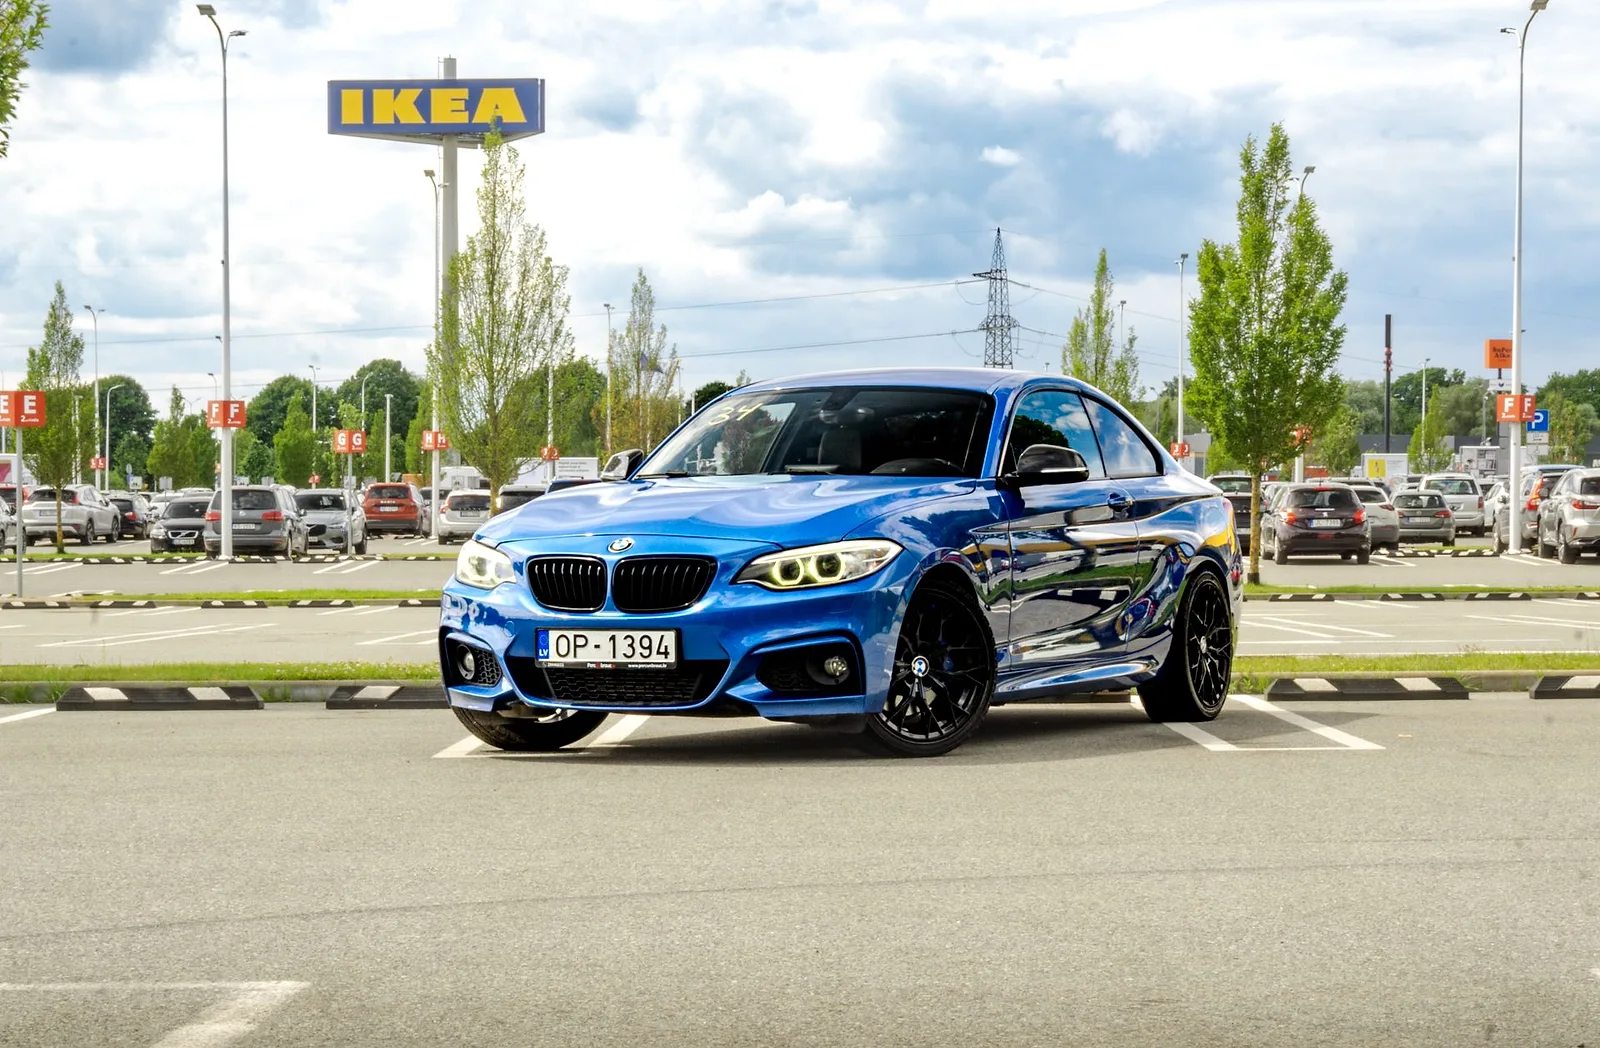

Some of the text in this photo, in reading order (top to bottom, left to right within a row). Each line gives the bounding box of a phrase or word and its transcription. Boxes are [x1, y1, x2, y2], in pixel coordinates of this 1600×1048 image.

[341, 88, 527, 124] IKEA
[0, 395, 9, 414] E
[24, 395, 36, 414] E
[212, 403, 220, 418] F
[230, 403, 239, 418] F
[1504, 398, 1514, 412] F
[1524, 398, 1532, 412] F
[1531, 412, 1544, 429] P
[337, 432, 346, 446] G
[352, 432, 362, 446] G
[425, 433, 432, 444] H
[539, 634, 670, 659] LV OP-1394
